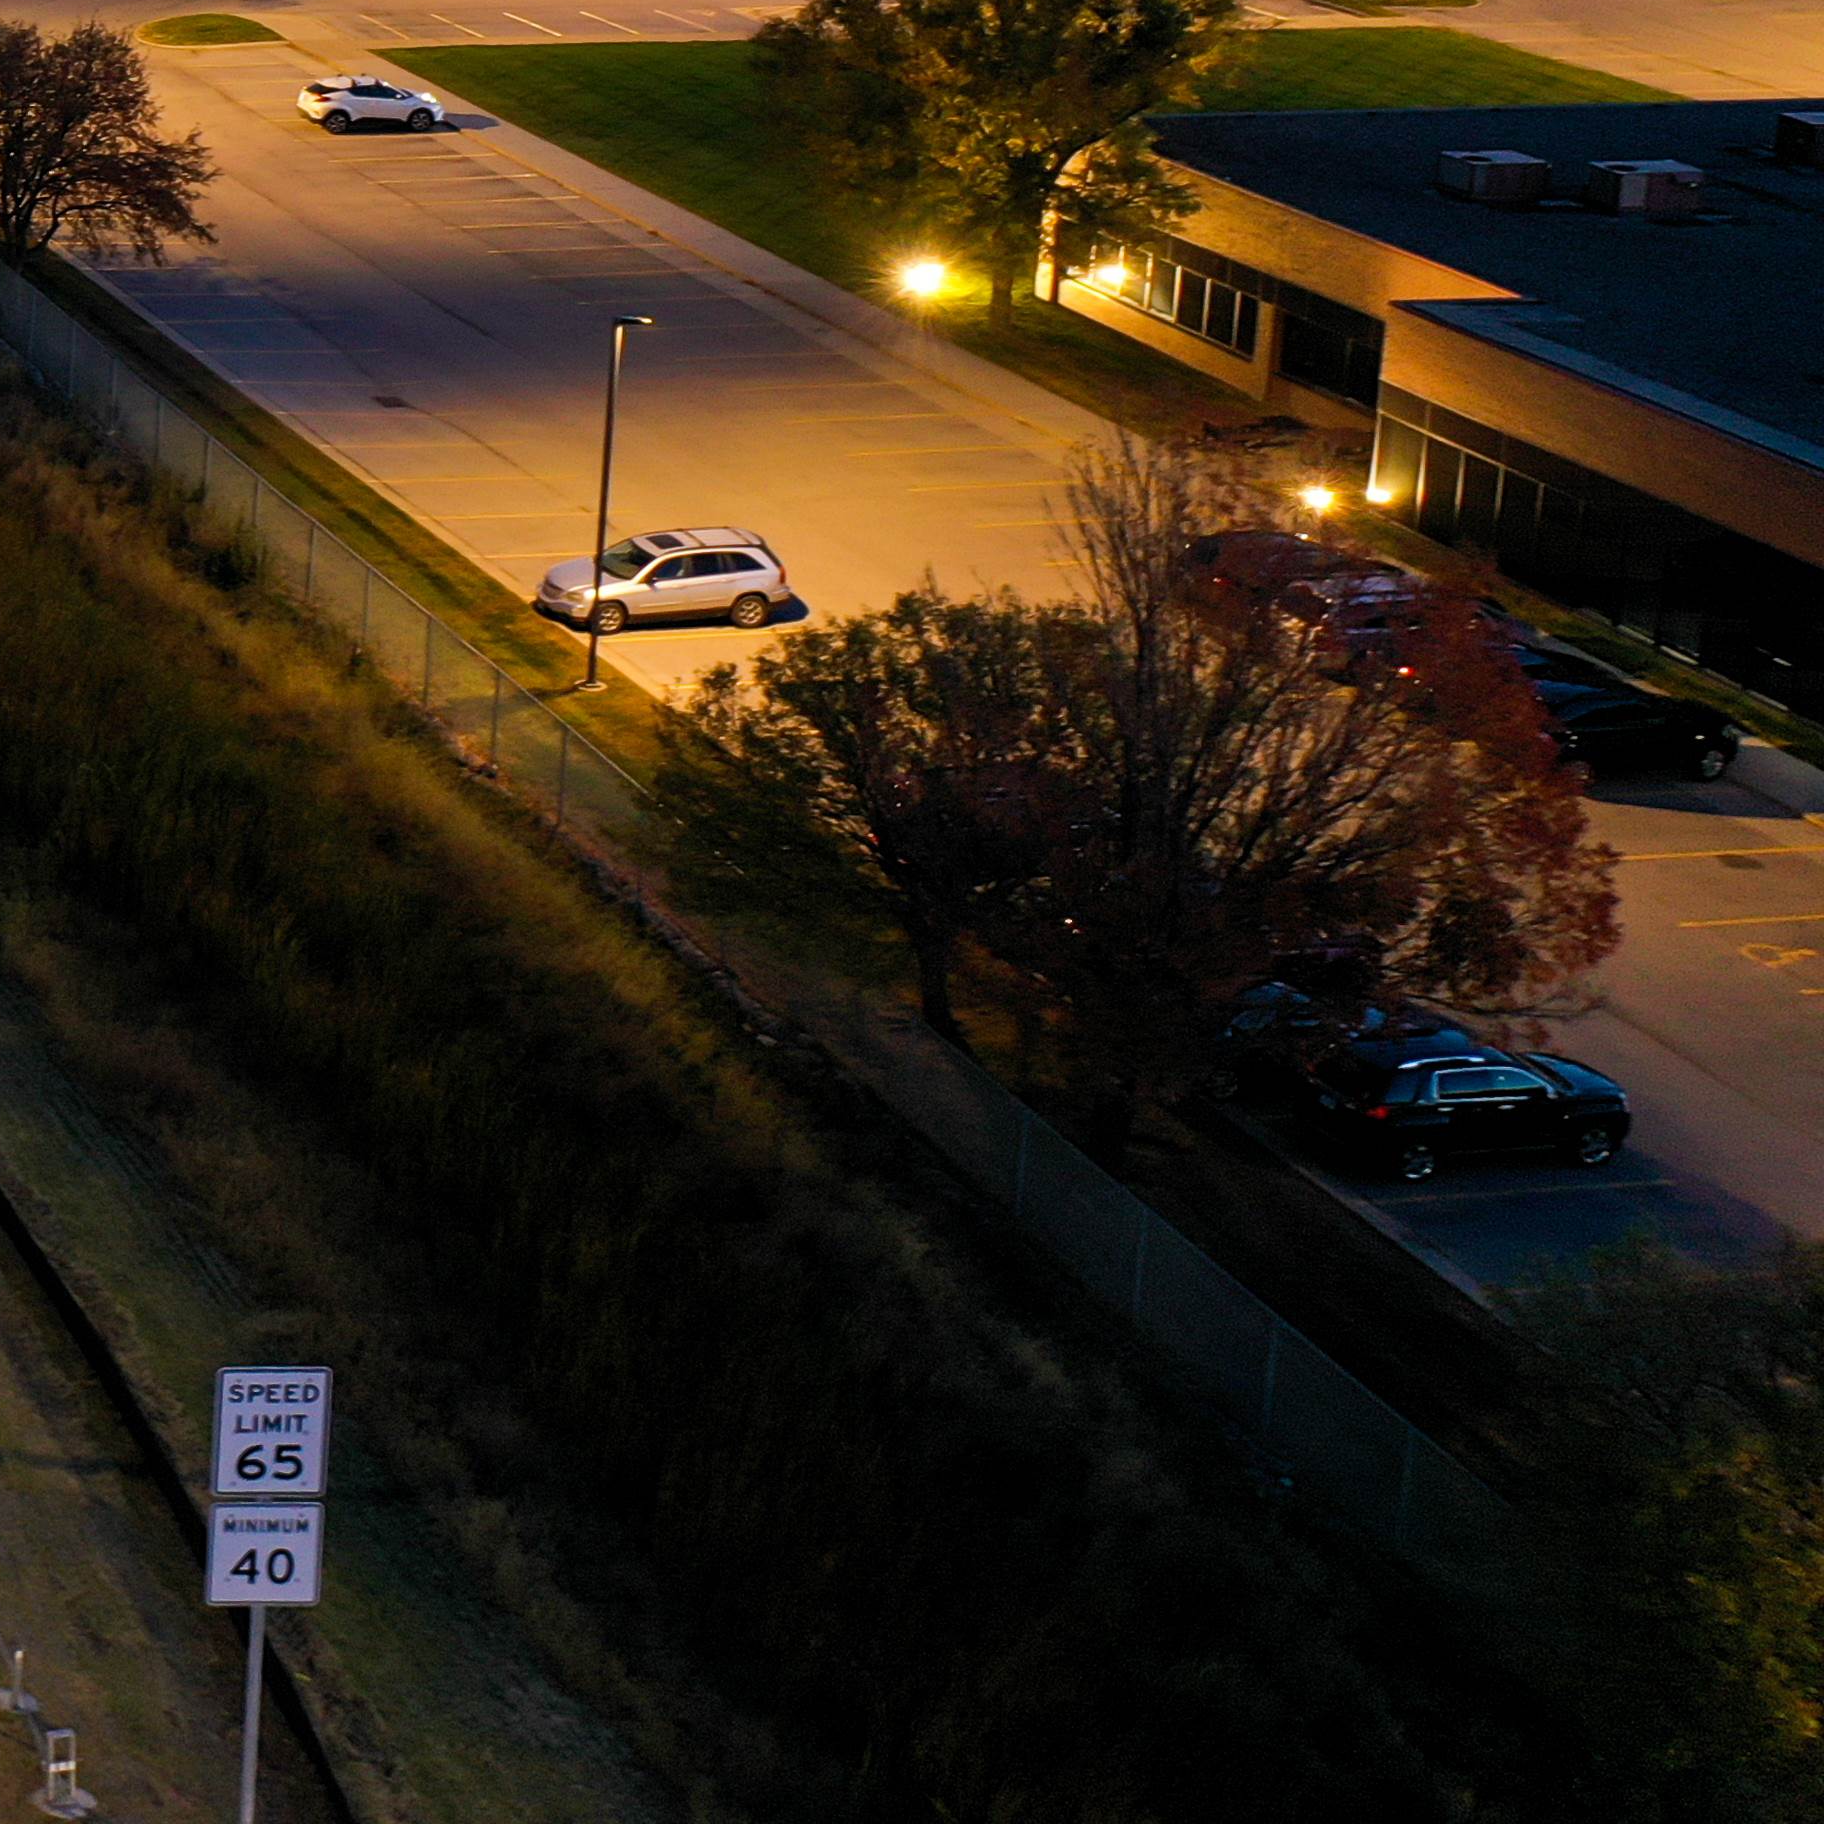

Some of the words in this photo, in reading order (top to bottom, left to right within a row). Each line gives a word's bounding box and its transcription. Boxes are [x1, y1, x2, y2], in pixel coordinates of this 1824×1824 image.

[228, 1384, 320, 1404] SPEED
[234, 1414, 308, 1434] LIMIT
[236, 1443, 303, 1481] 65
[223, 1518, 309, 1534] MINIMUM
[230, 1547, 295, 1585] 40
